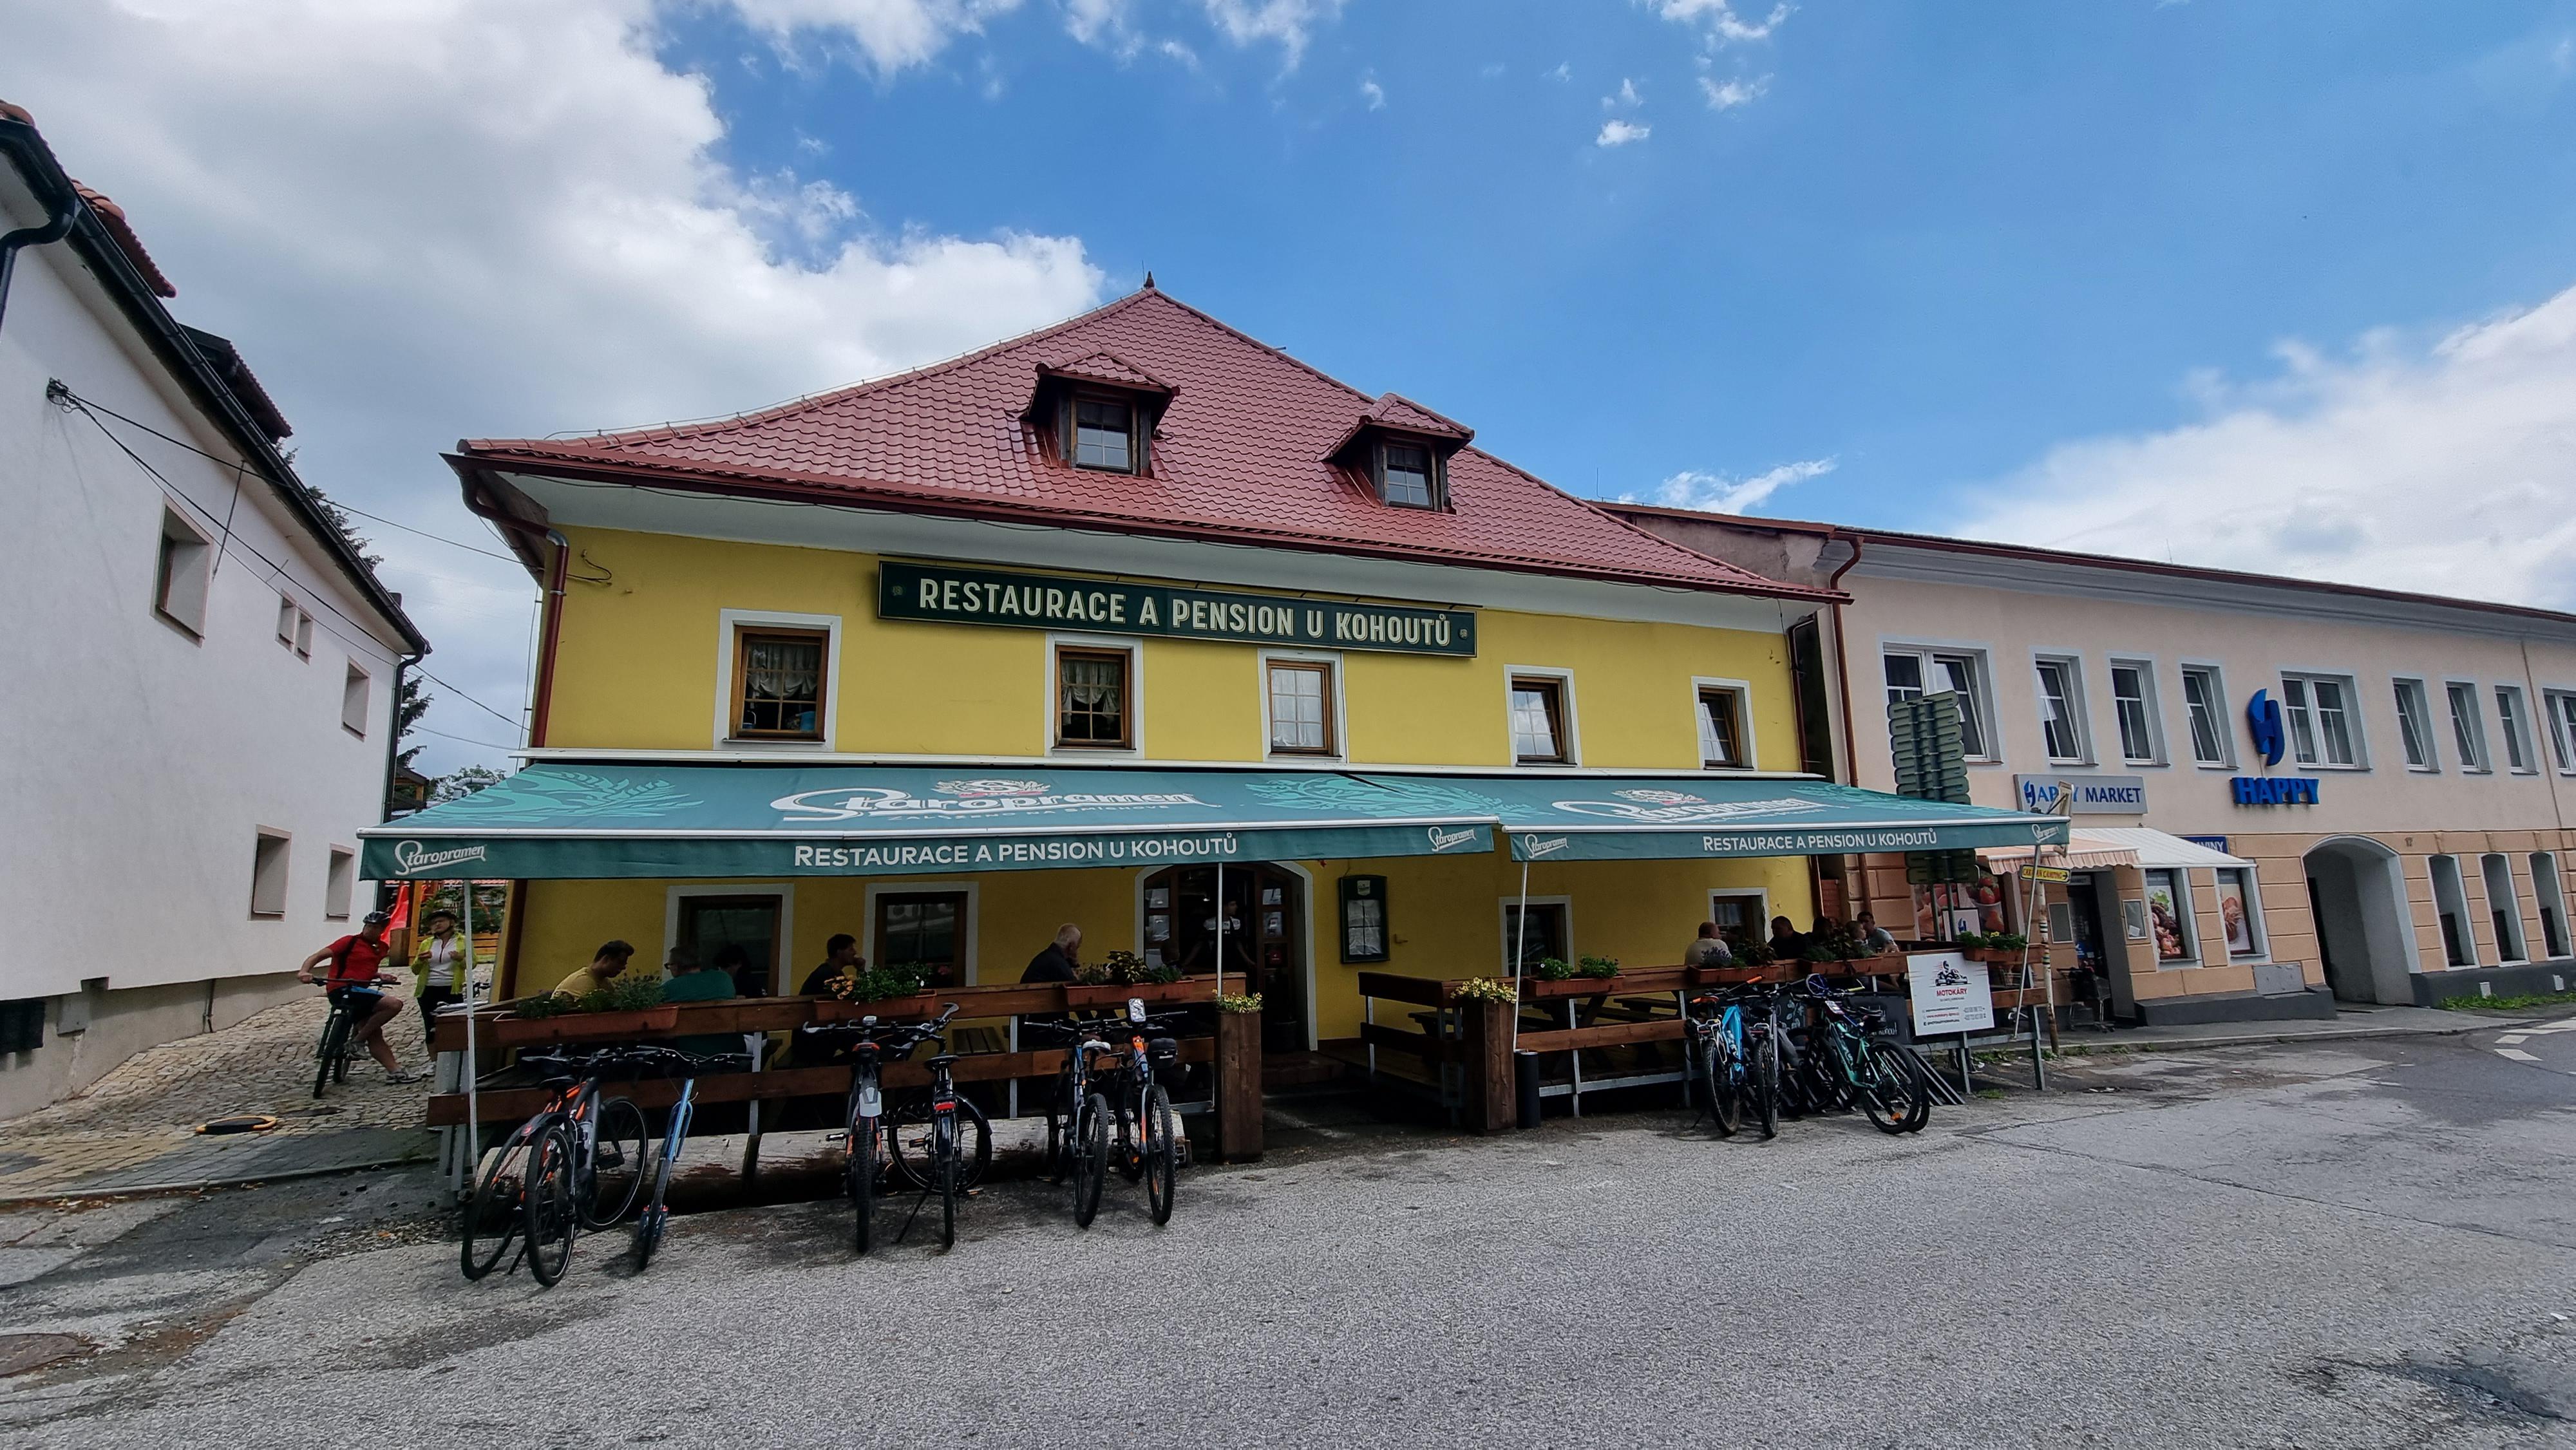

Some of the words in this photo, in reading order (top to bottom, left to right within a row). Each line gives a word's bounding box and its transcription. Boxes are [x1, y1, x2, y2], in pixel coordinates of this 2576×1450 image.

[920, 578, 1127, 625] RESTAURACE
[1139, 596, 1160, 626] A
[1172, 598, 1294, 637] PENSION
[1306, 610, 1324, 638] U
[1335, 612, 1450, 646] KOHOUTŮ
[770, 787, 1222, 822] Staropramen
[2085, 787, 2141, 803] MARKET
[2230, 777, 2320, 805] HAPPY
[794, 845, 969, 867] RESTAURACE
[975, 844, 992, 862] A
[999, 841, 1103, 862] PENSION
[1110, 841, 1125, 858] U
[1132, 833, 1237, 858] KOHOUTŮ
[1428, 826, 1477, 852] Staropramen
[1703, 836, 1794, 852] RESTAURACE
[1796, 835, 1808, 849] A
[1809, 833, 1867, 849] PENSION
[1868, 833, 1877, 847] U
[1879, 827, 1938, 845] KOHOUTŮ
[395, 840, 487, 876] Staropramen
